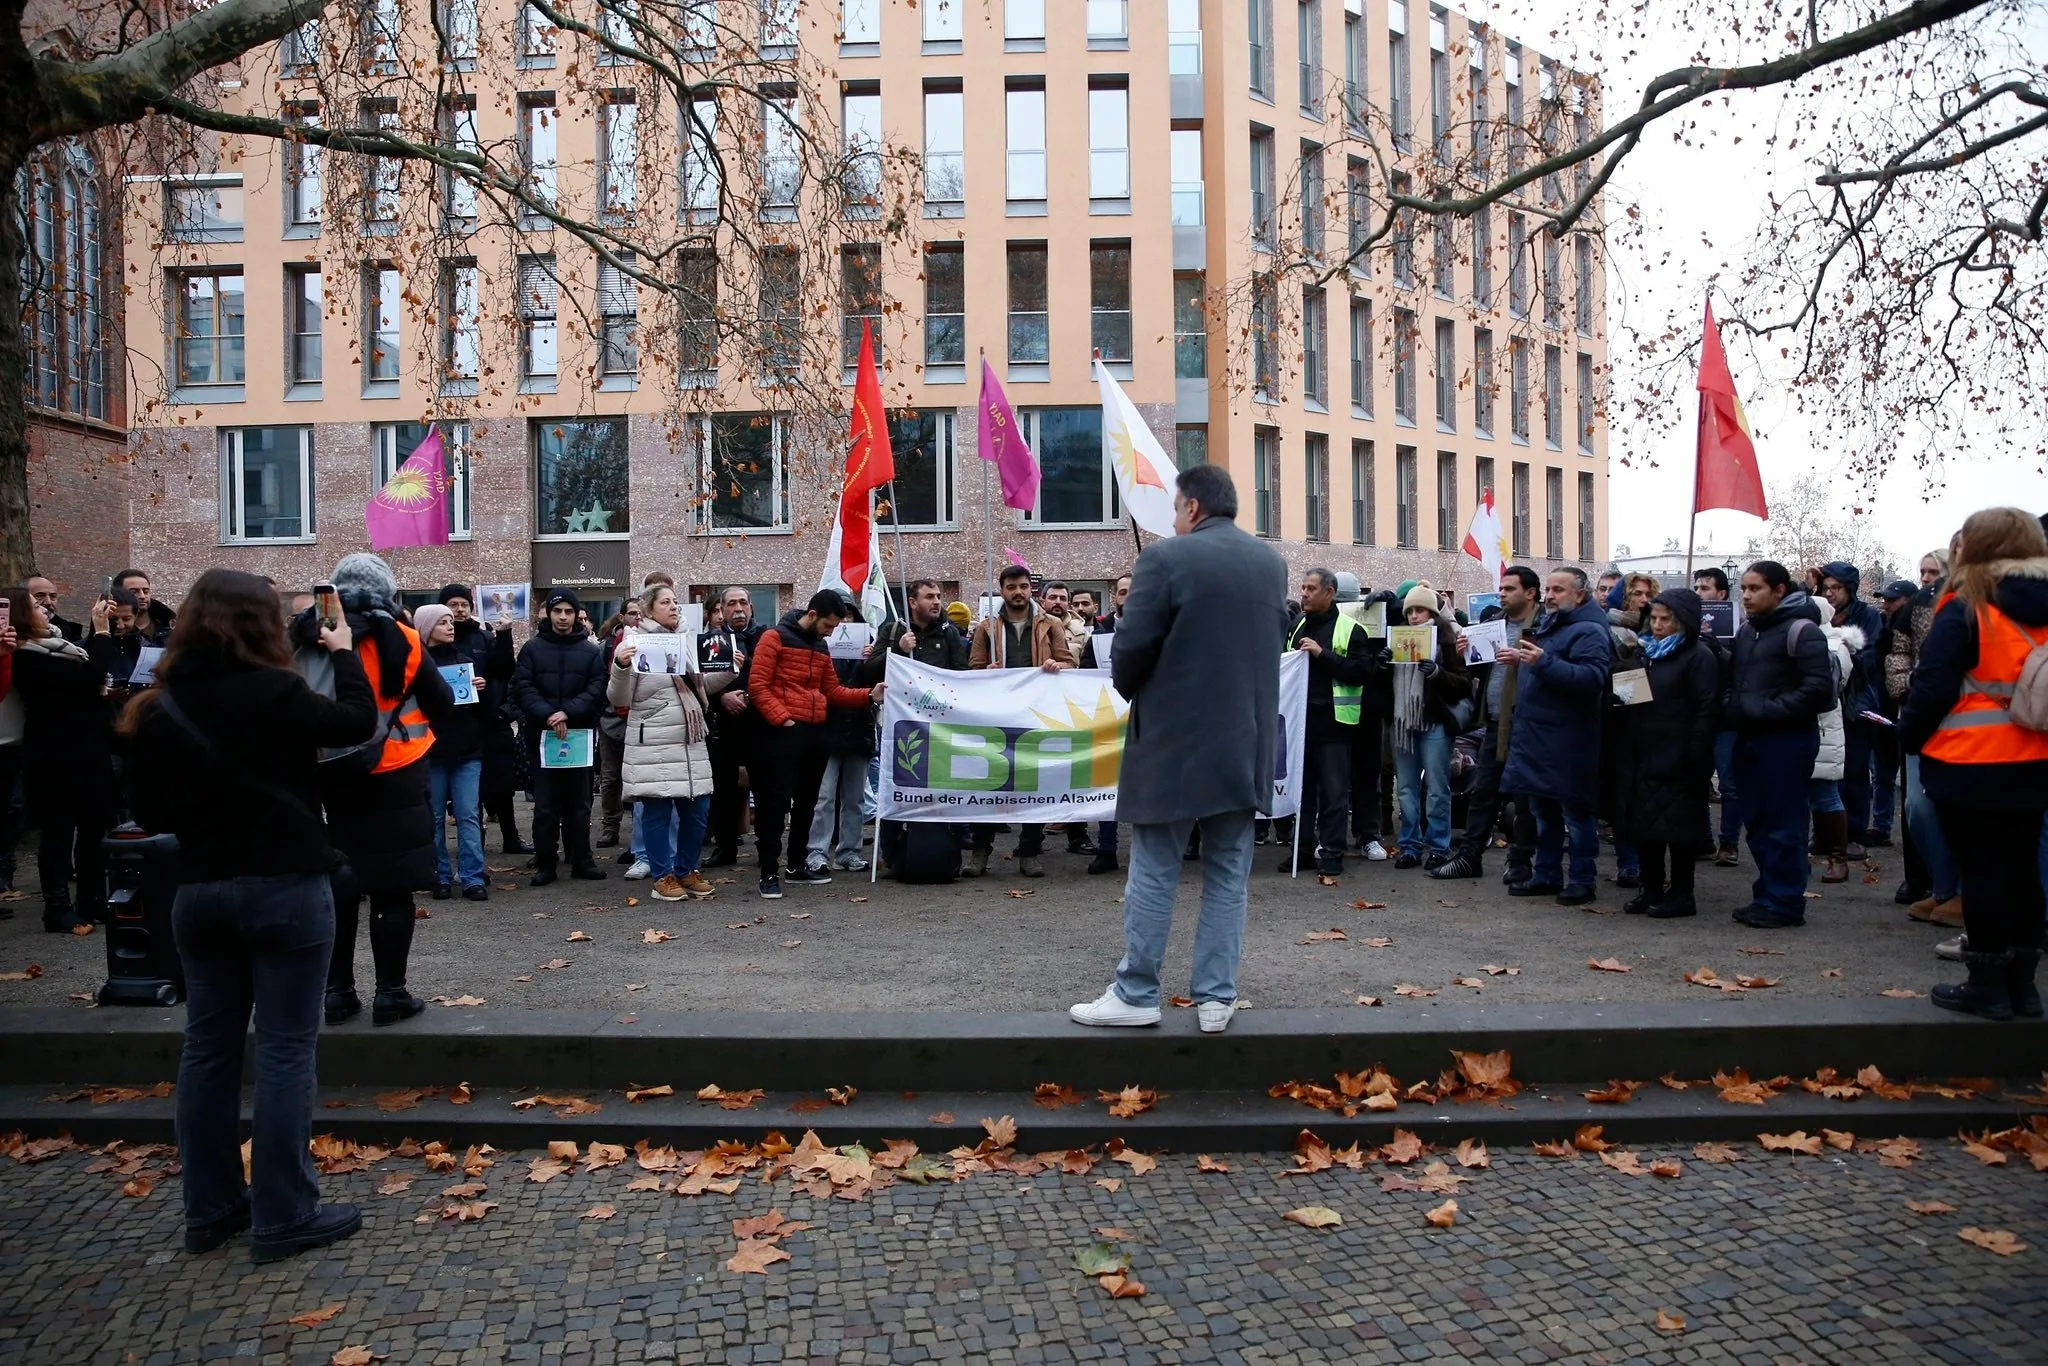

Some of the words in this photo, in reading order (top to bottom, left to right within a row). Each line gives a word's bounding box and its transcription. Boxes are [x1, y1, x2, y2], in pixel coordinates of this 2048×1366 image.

[433, 470, 445, 494] YJAD
[579, 562, 586, 572] 6
[551, 577, 590, 585] Bertelsmann
[590, 577, 616, 585] Stiftung
[928, 722, 1122, 792] BA
[893, 791, 934, 804] Bund
[938, 794, 964, 805] der
[967, 794, 1056, 806] Arabischen
[1059, 792, 1116, 804] Alawite
[1274, 785, 1287, 796] V.
